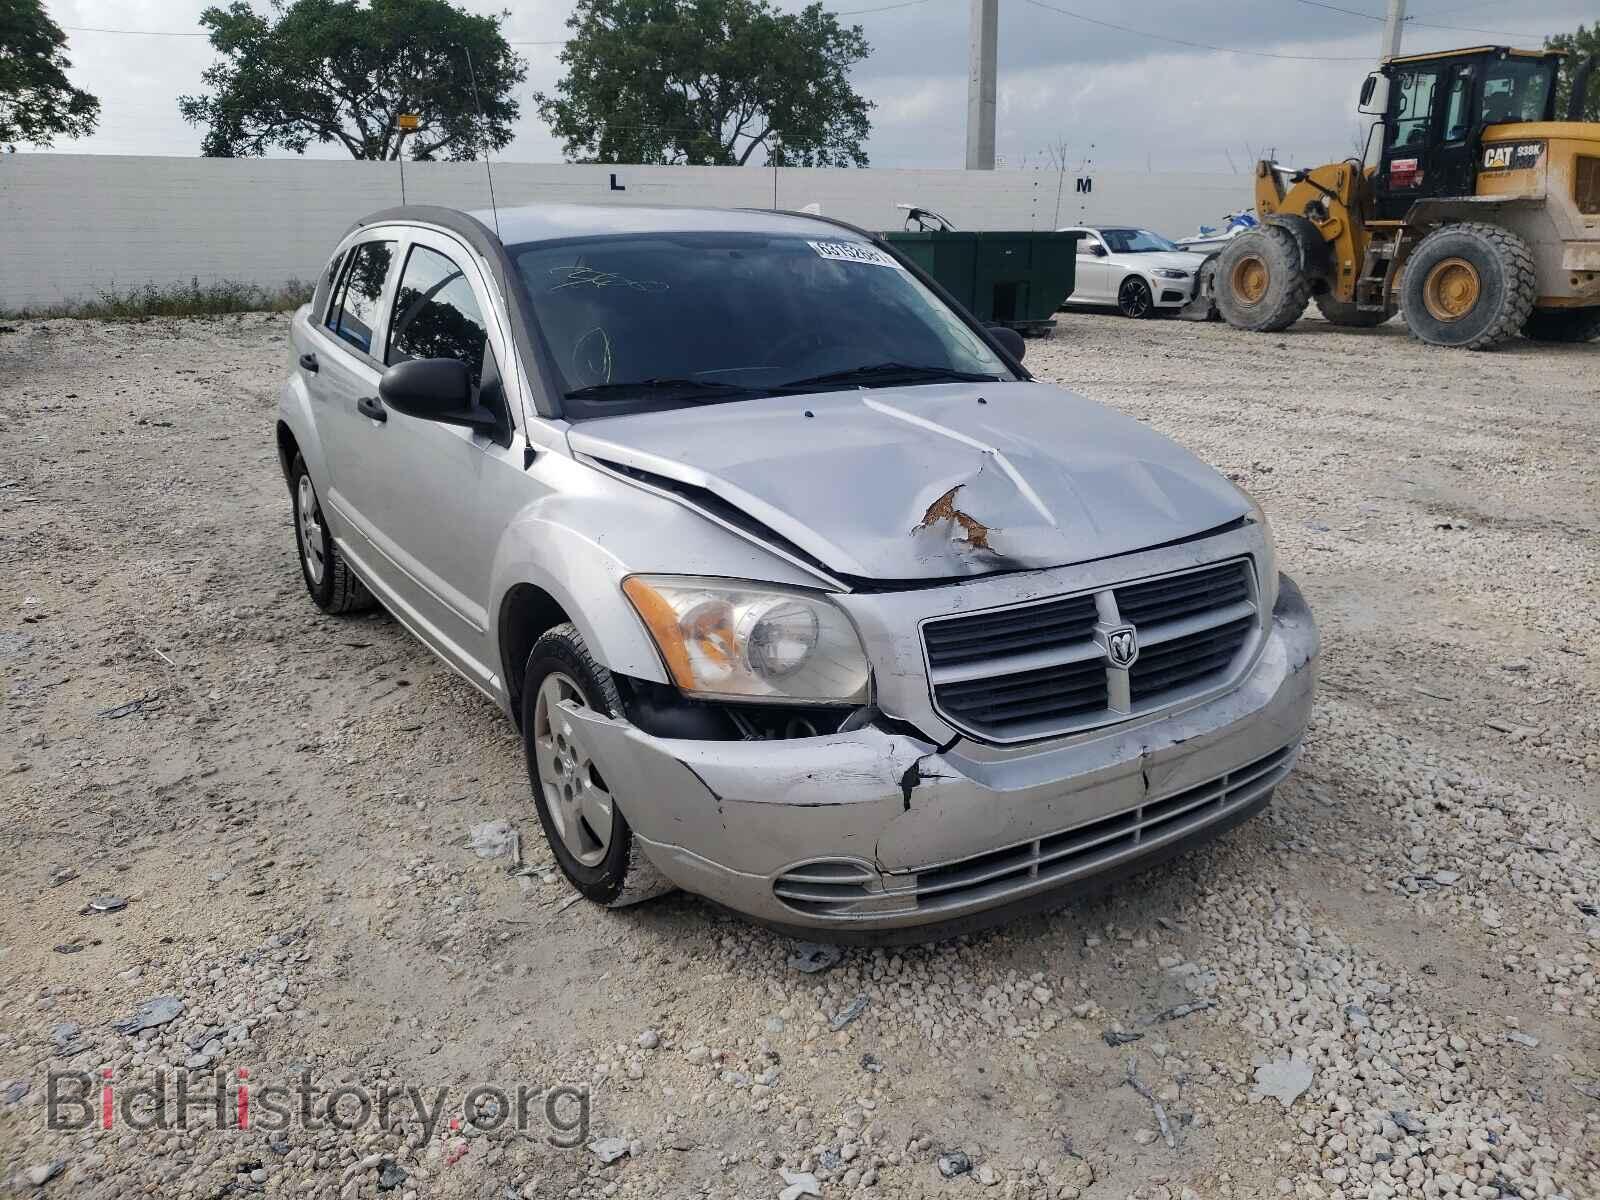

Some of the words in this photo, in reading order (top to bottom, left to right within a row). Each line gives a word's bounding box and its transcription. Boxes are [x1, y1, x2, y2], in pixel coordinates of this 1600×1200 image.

[1485, 147, 1514, 168] CAT
[610, 173, 626, 191] L
[1076, 177, 1092, 193] M
